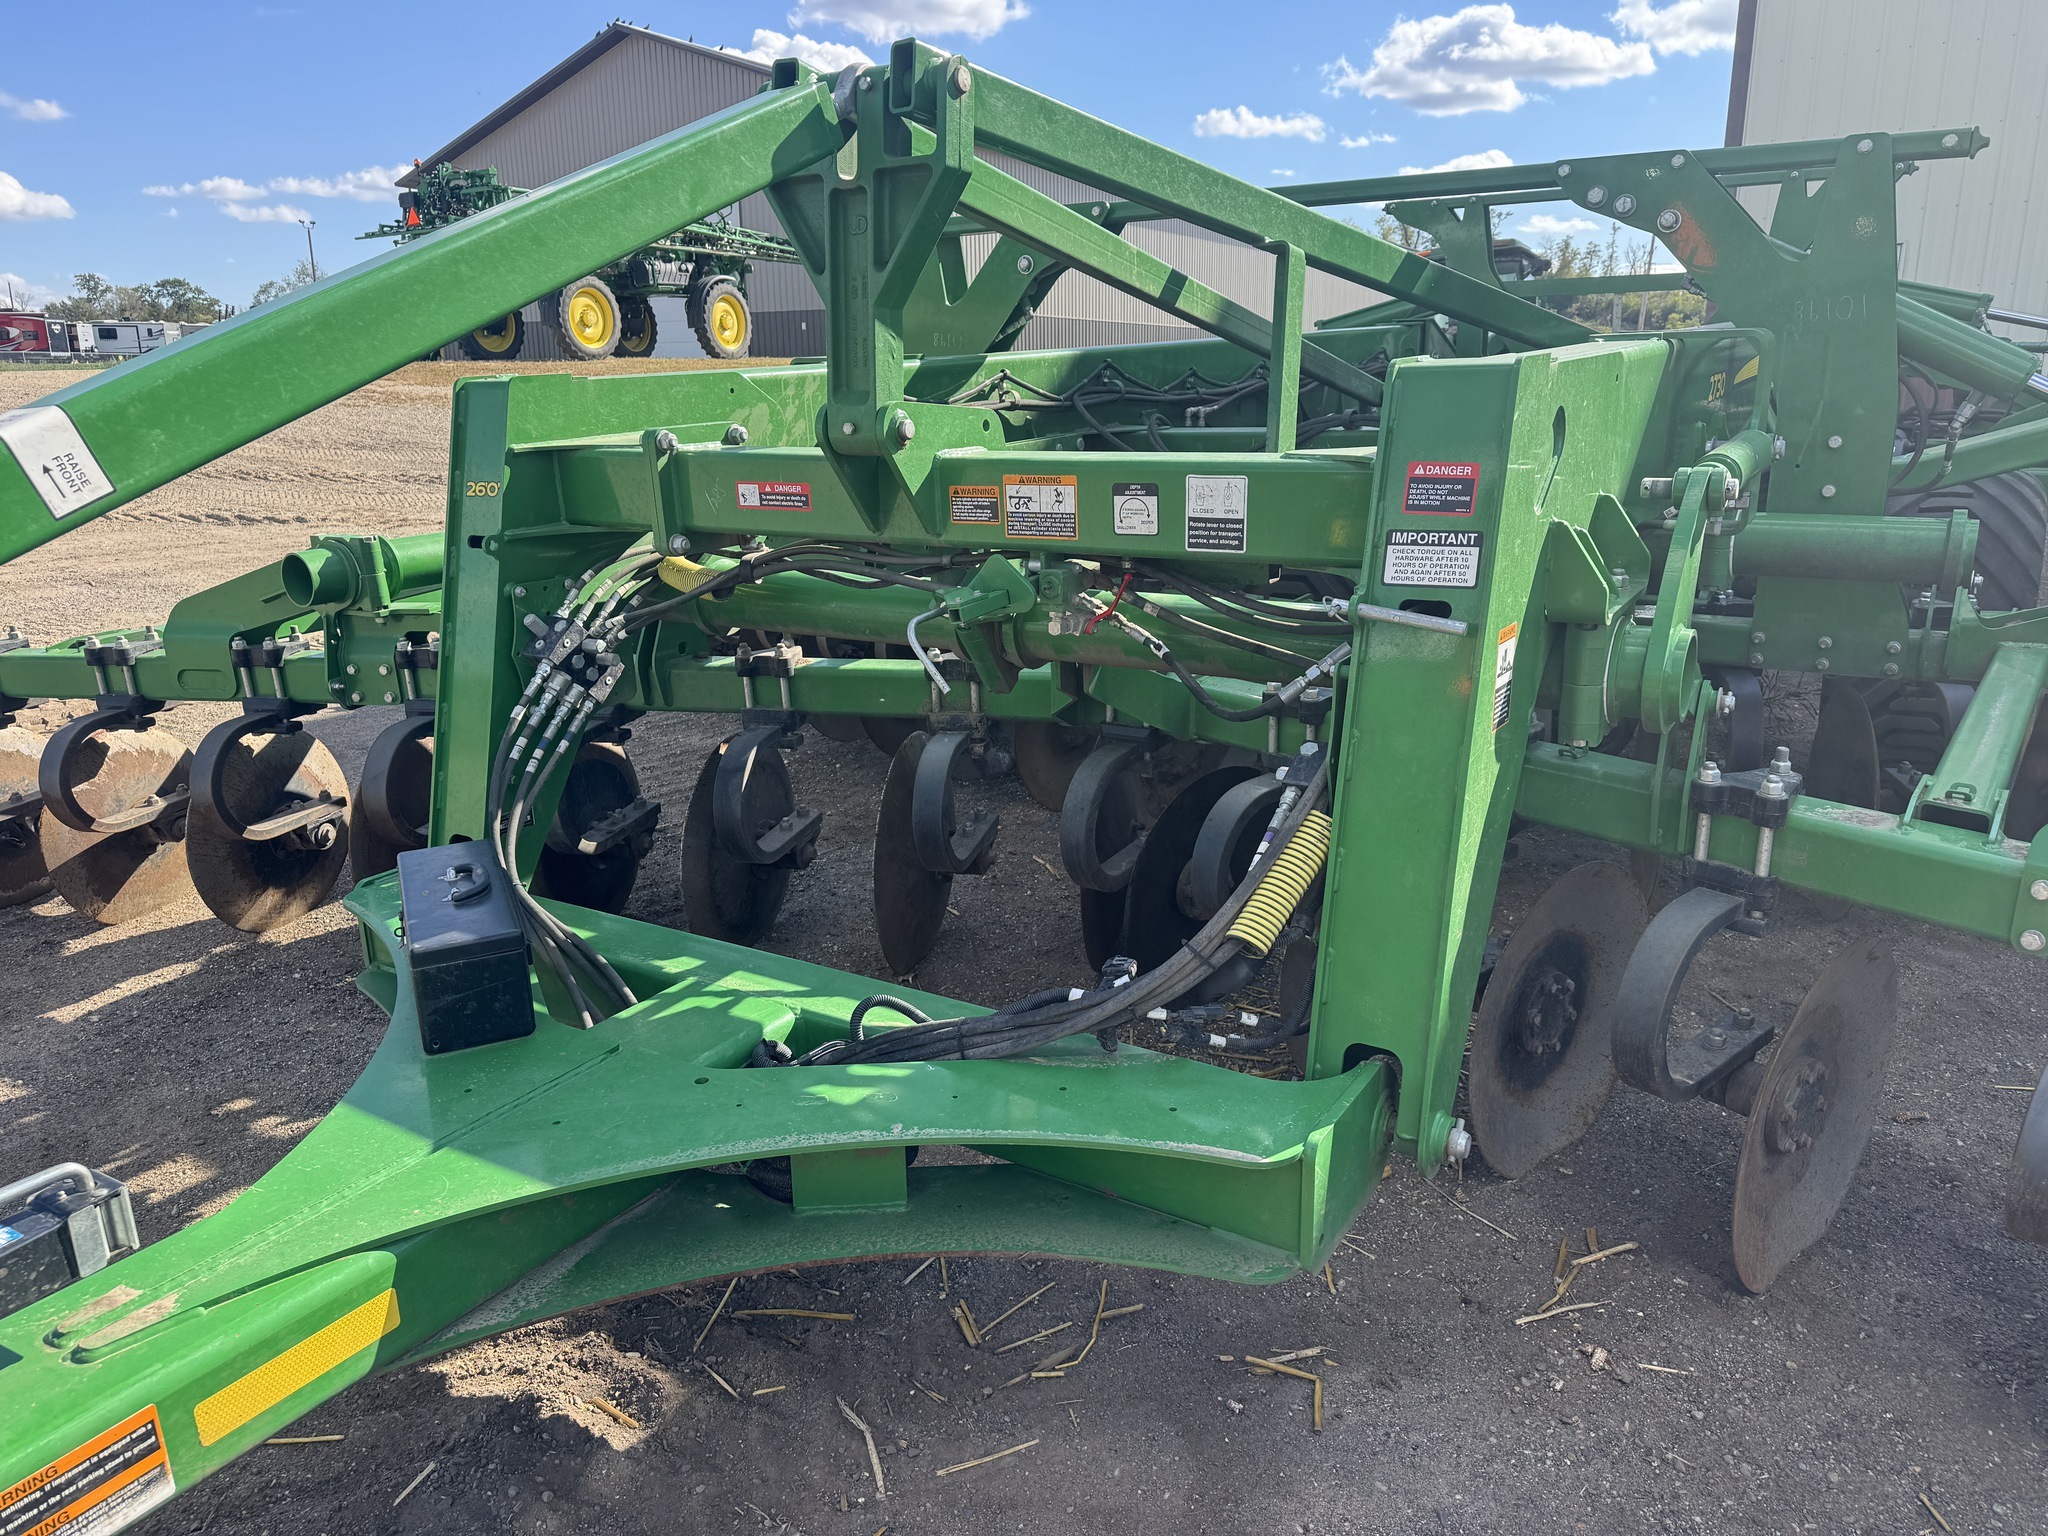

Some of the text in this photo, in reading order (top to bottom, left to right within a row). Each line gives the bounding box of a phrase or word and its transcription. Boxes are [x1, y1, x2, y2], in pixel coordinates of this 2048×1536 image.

[1708, 372, 1726, 402] 2730
[52, 456, 83, 493] FRONT
[64, 452, 92, 488] RAISE
[1426, 466, 1471, 475] DANGER
[1391, 532, 1478, 545] IMPORTANT
[0, 1466, 58, 1508] RNING
[26, 1511, 70, 1536] NING
